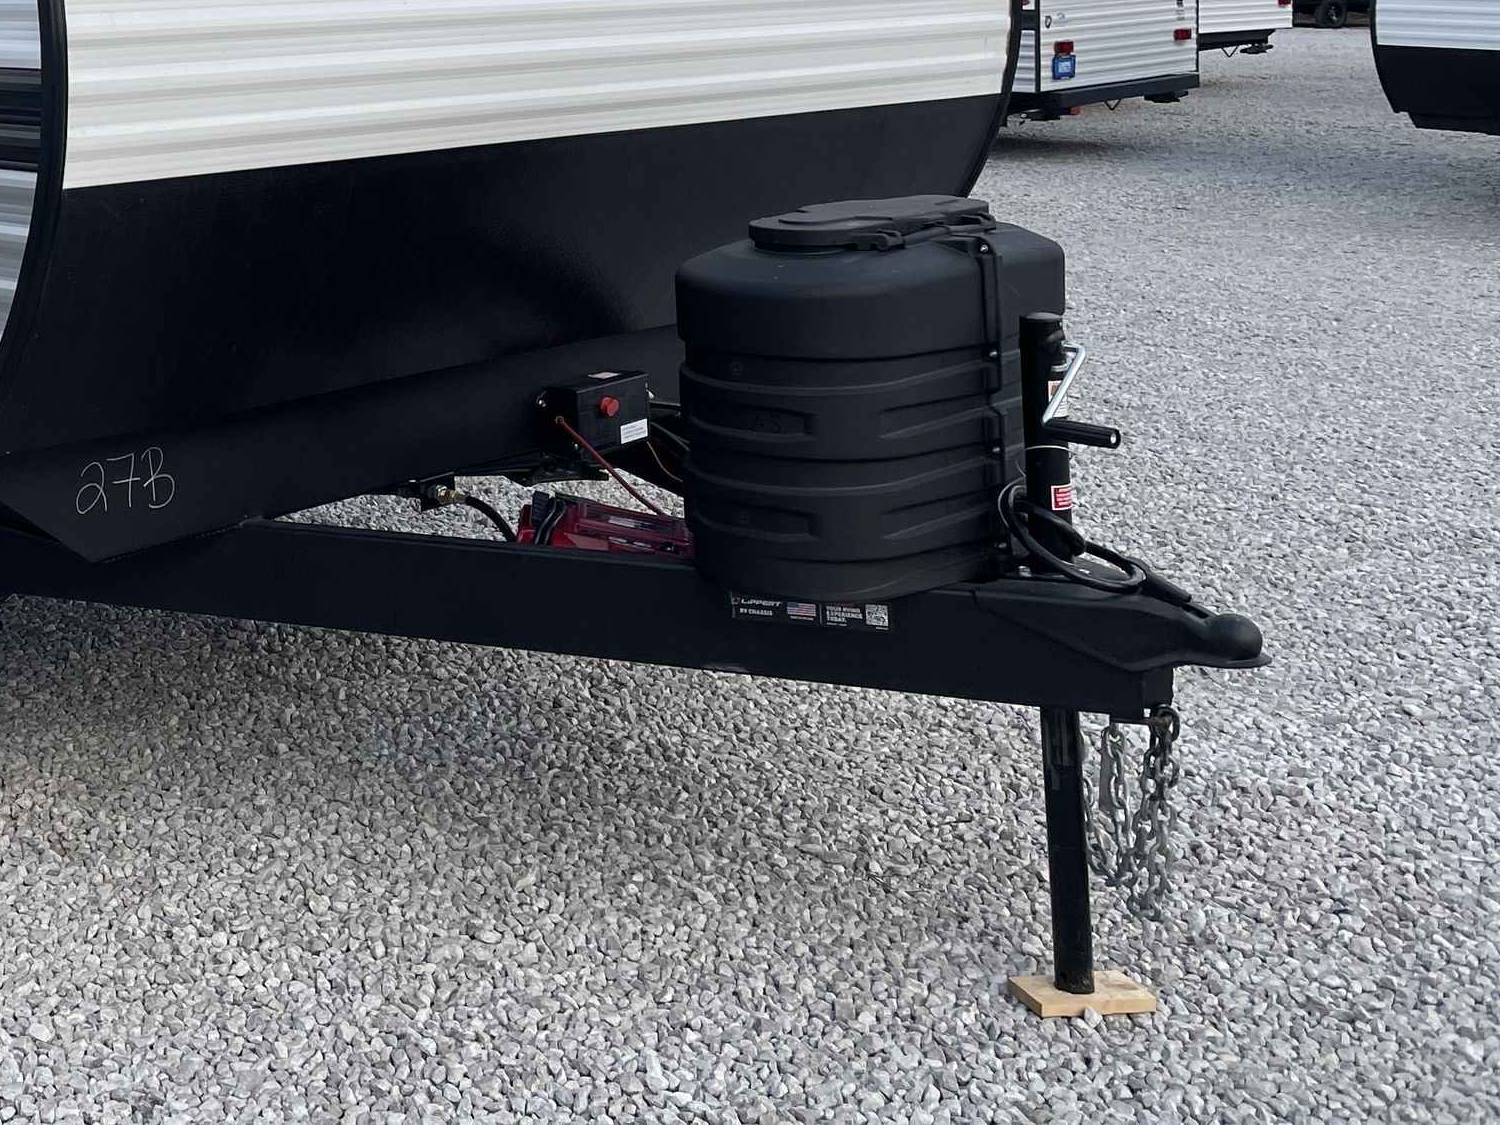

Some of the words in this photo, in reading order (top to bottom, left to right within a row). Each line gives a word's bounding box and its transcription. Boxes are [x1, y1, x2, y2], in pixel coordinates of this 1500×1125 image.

[75, 446, 176, 515] 27B
[748, 608, 773, 616] CHASSIS
[826, 610, 863, 619] EXPERIENCE
